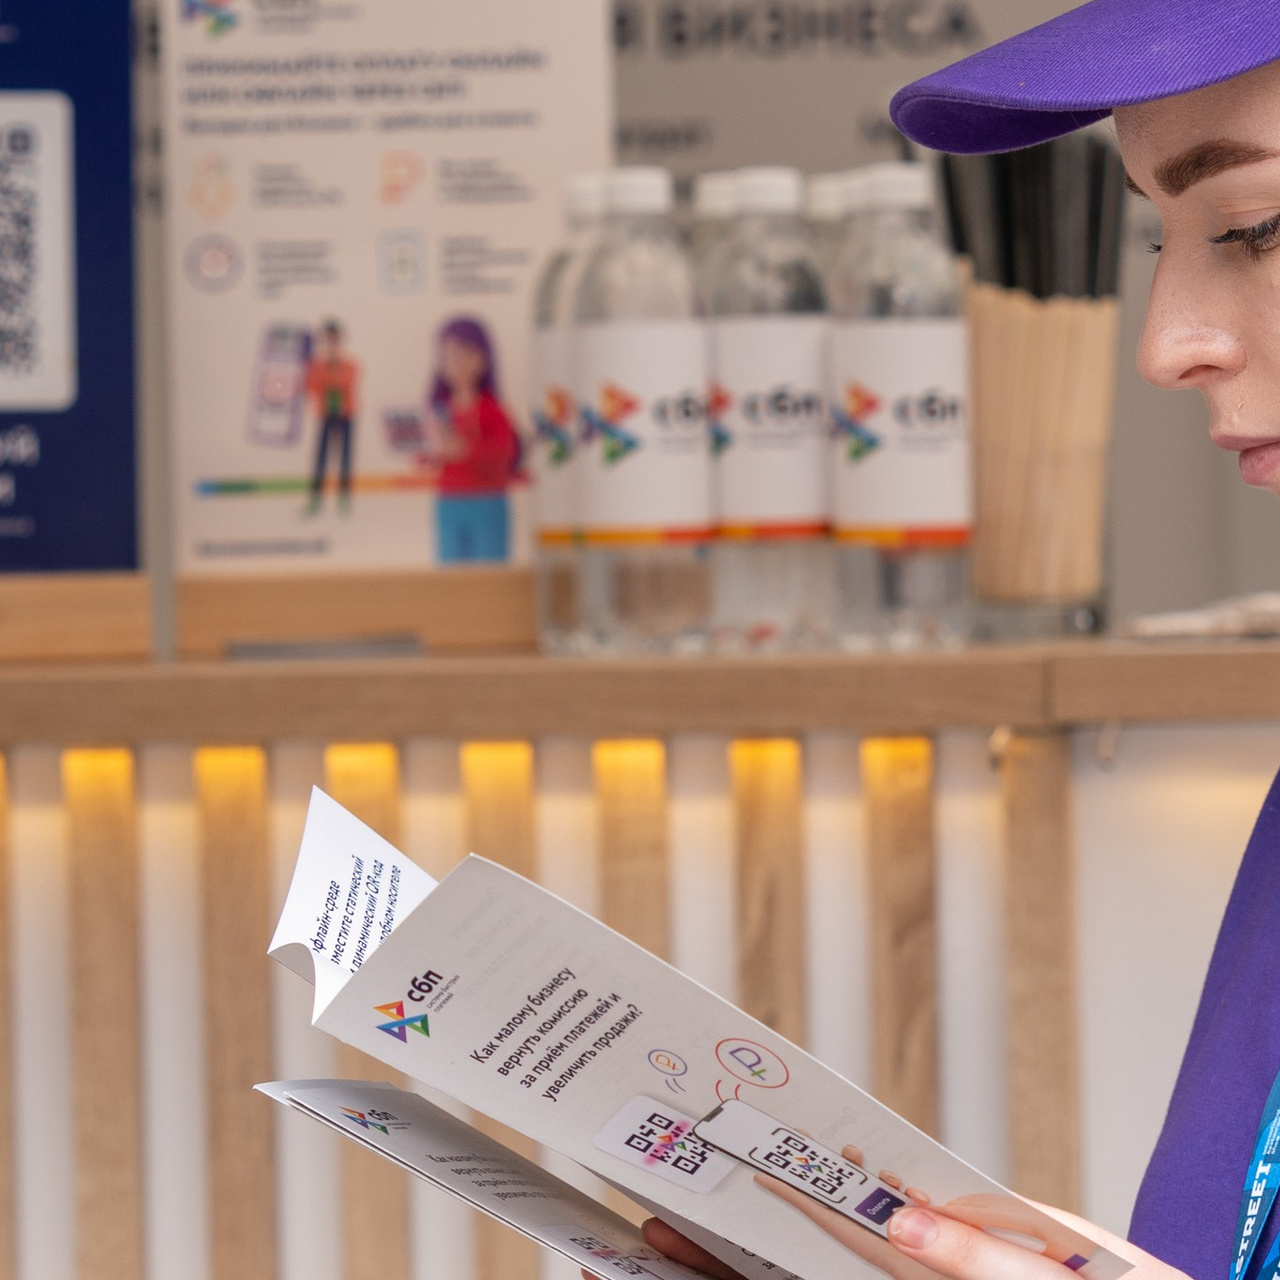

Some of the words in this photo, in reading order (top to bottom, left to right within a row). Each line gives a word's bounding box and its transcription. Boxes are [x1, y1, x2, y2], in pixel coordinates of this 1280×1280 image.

[345, 854, 365, 916] статический
[352, 891, 379, 969] динамический
[366, 859, 385, 895] QR-код
[388, 865, 401, 906] носителе
[407, 969, 444, 1002] сбп
[469, 1041, 500, 1064] Как
[494, 1004, 538, 1043] малому
[527, 967, 576, 1007] бизнесу
[497, 1035, 541, 1076] вернуть
[536, 988, 588, 1035] комиссию
[520, 1073, 538, 1088] за
[532, 1042, 569, 1076] приём
[563, 998, 614, 1044] платежей
[608, 992, 622, 1003] и
[542, 1049, 597, 1102] увеличить
[592, 1003, 643, 1052] продажи?
